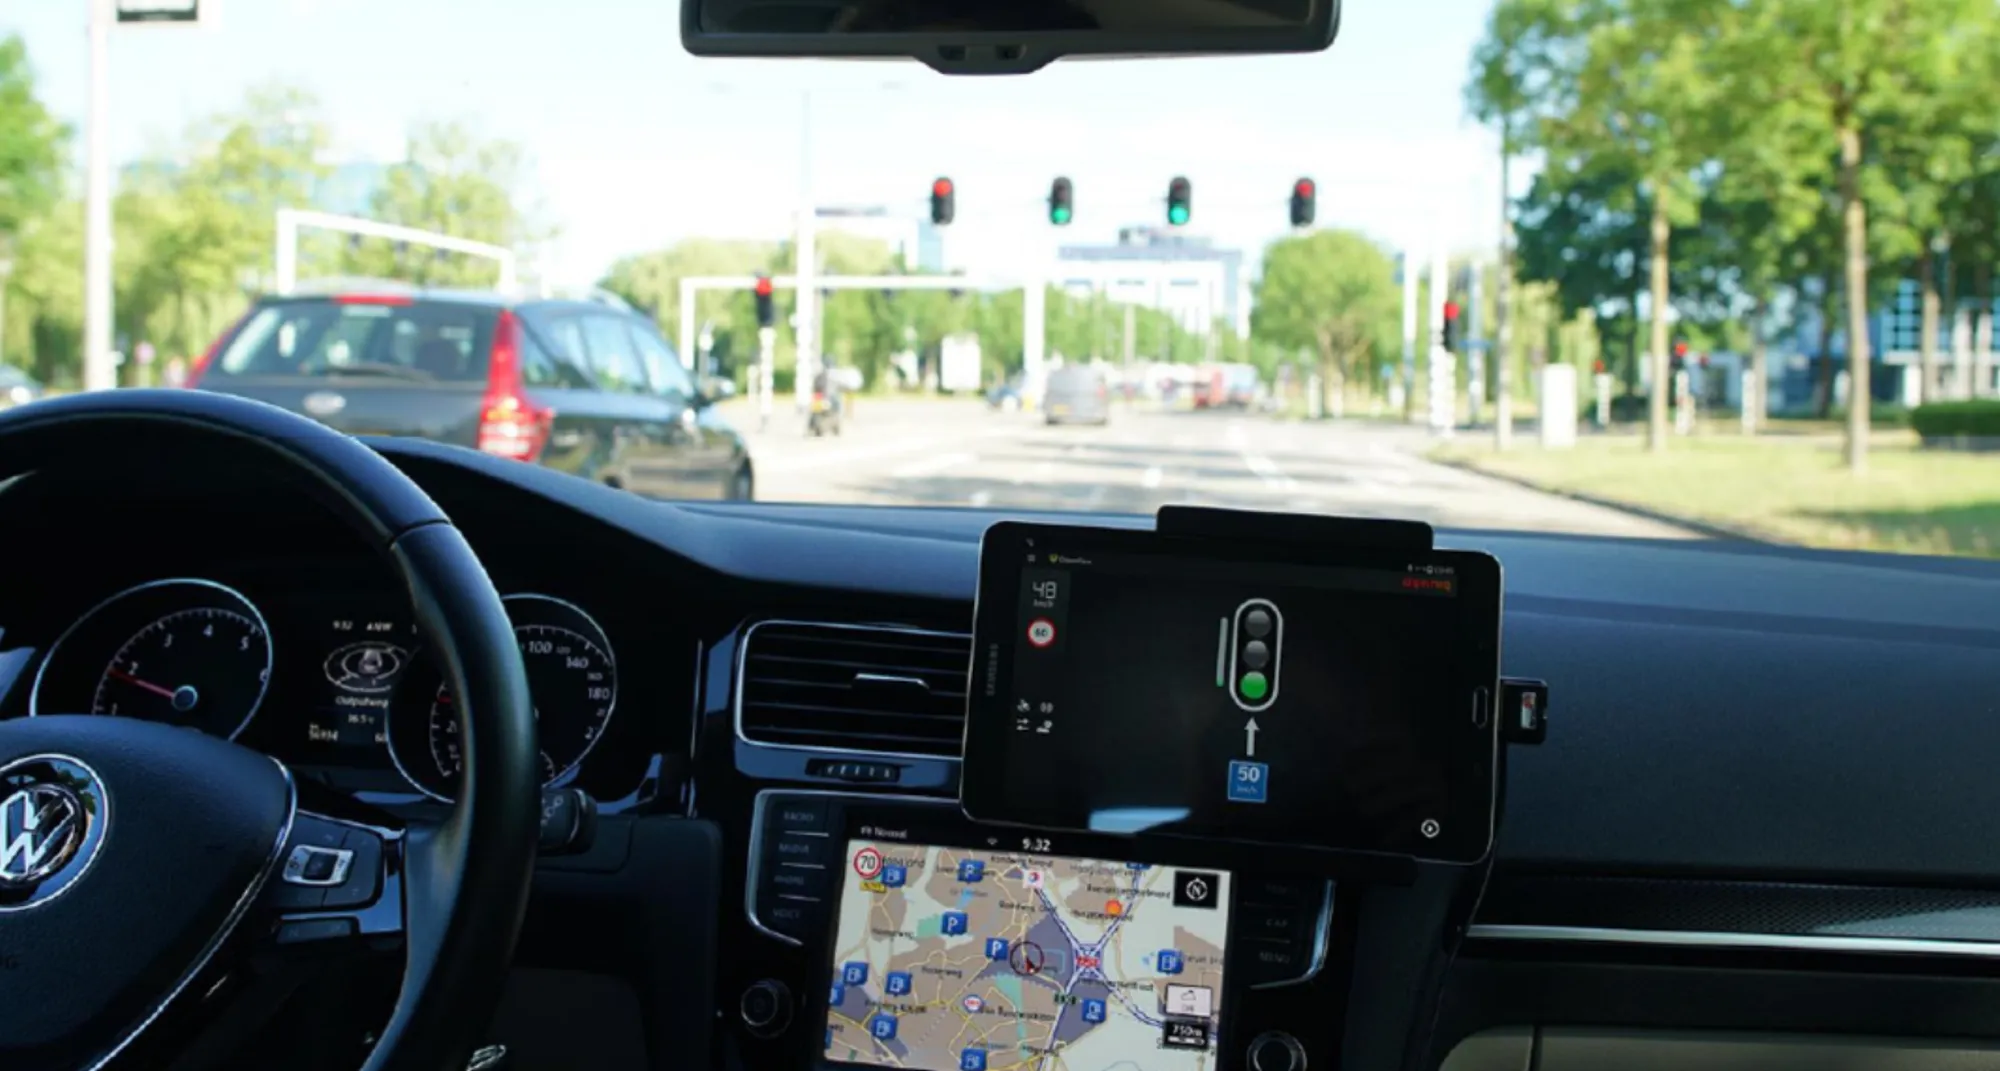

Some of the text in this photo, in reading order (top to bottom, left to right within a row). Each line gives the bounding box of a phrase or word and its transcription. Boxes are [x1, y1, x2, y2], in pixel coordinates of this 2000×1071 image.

[1032, 581, 1057, 599] 48
[202, 623, 214, 638] 4
[163, 633, 175, 648] 3
[239, 635, 250, 651] 5
[528, 641, 554, 654] 100
[128, 661, 140, 677] 2
[566, 656, 590, 669] 140
[588, 687, 611, 700] 180
[1237, 766, 1260, 783] 50
[1022, 838, 1051, 852] 9.32
[861, 856, 876, 869] 70
